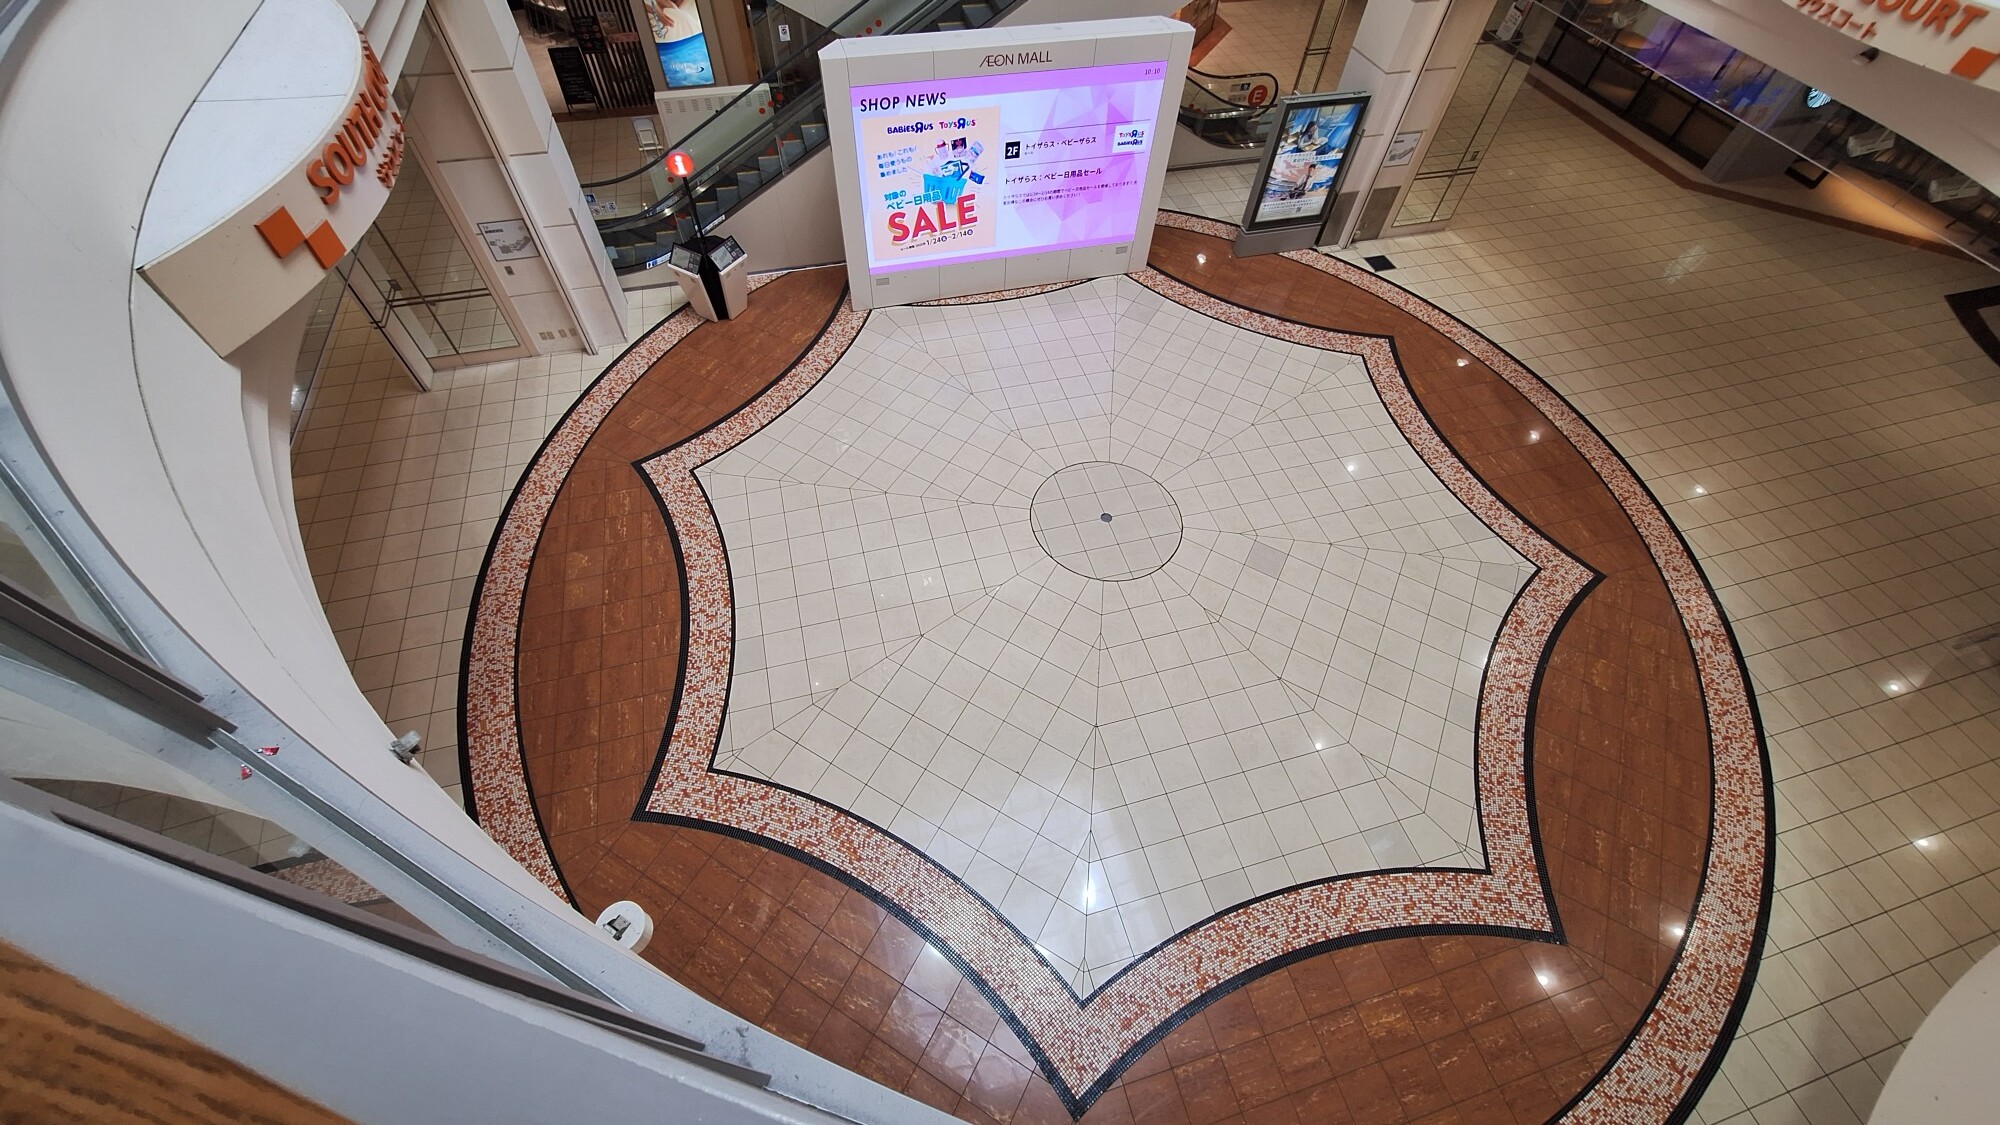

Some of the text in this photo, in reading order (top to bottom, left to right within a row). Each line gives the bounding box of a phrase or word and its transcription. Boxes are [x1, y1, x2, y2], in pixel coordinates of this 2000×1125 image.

[1017, 51, 1053, 65] MALL
[860, 92, 947, 112] SHOP NEWS
[306, 90, 383, 206] SOUTH
[1006, 146, 1019, 156] 2F
[886, 190, 942, 210] ベビー日用品
[888, 193, 978, 243] SALE
